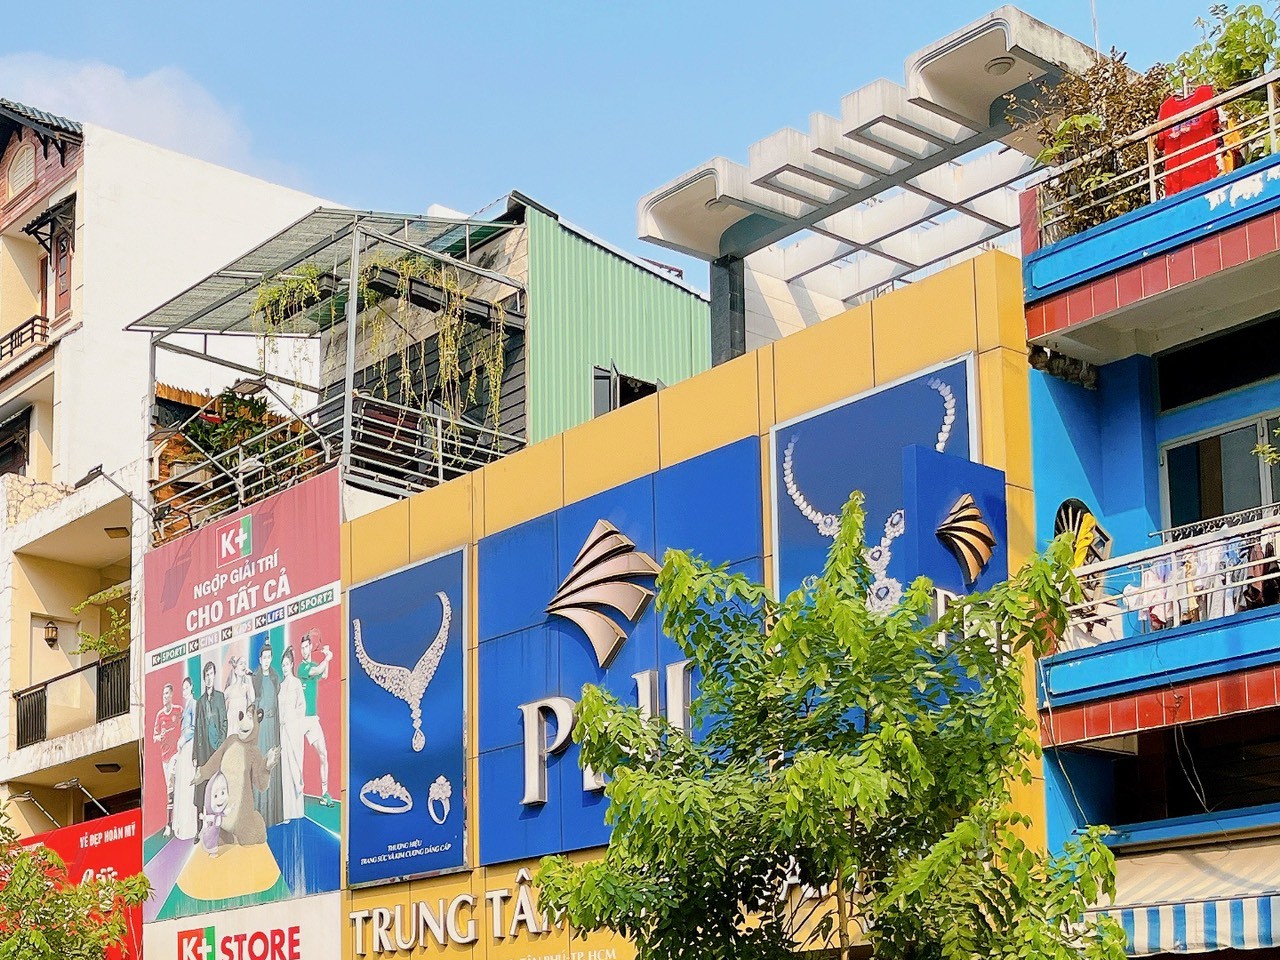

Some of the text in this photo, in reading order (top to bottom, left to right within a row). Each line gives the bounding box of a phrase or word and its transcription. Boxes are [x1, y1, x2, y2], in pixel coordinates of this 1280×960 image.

[220, 527, 248, 559] K+
[229, 560, 256, 585] GIẢI
[257, 548, 279, 574] TRÍ
[186, 567, 291, 632] CHO TẤT CẢ
[267, 607, 284, 625] LIFE
[350, 892, 479, 956] TRUNG
